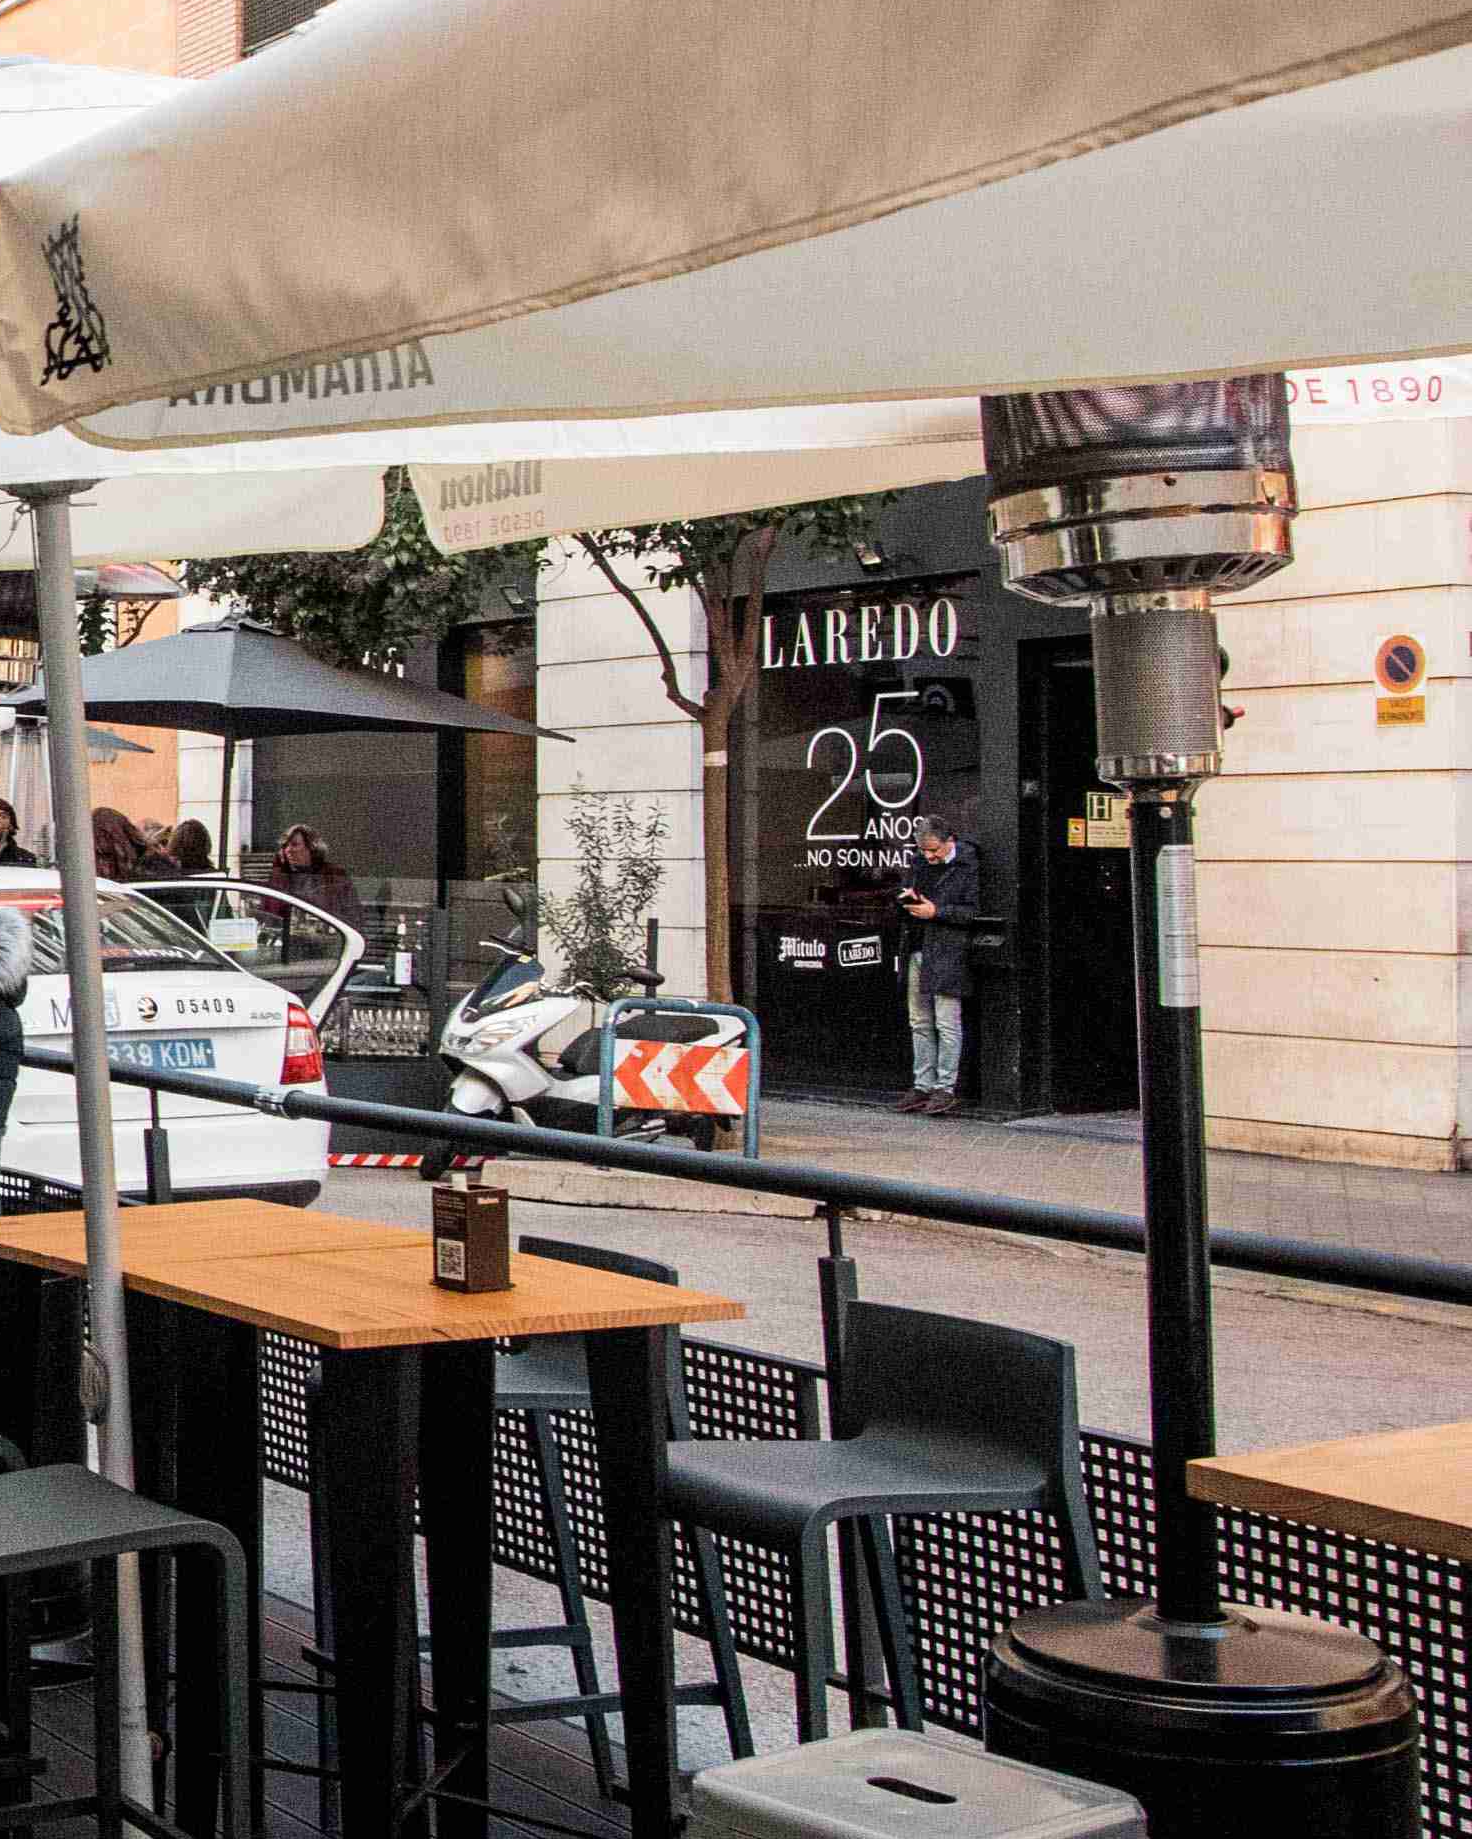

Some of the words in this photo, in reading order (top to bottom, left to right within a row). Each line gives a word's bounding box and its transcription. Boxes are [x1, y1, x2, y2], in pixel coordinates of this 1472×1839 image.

[1346, 375, 1443, 405] 1890
[760, 597, 958, 670] LAREDO
[806, 691, 923, 841] 25
[837, 848, 873, 867] SON
[878, 849, 914, 868] NAD
[175, 997, 236, 1015] 05409
[159, 1040, 208, 1068] KDM
